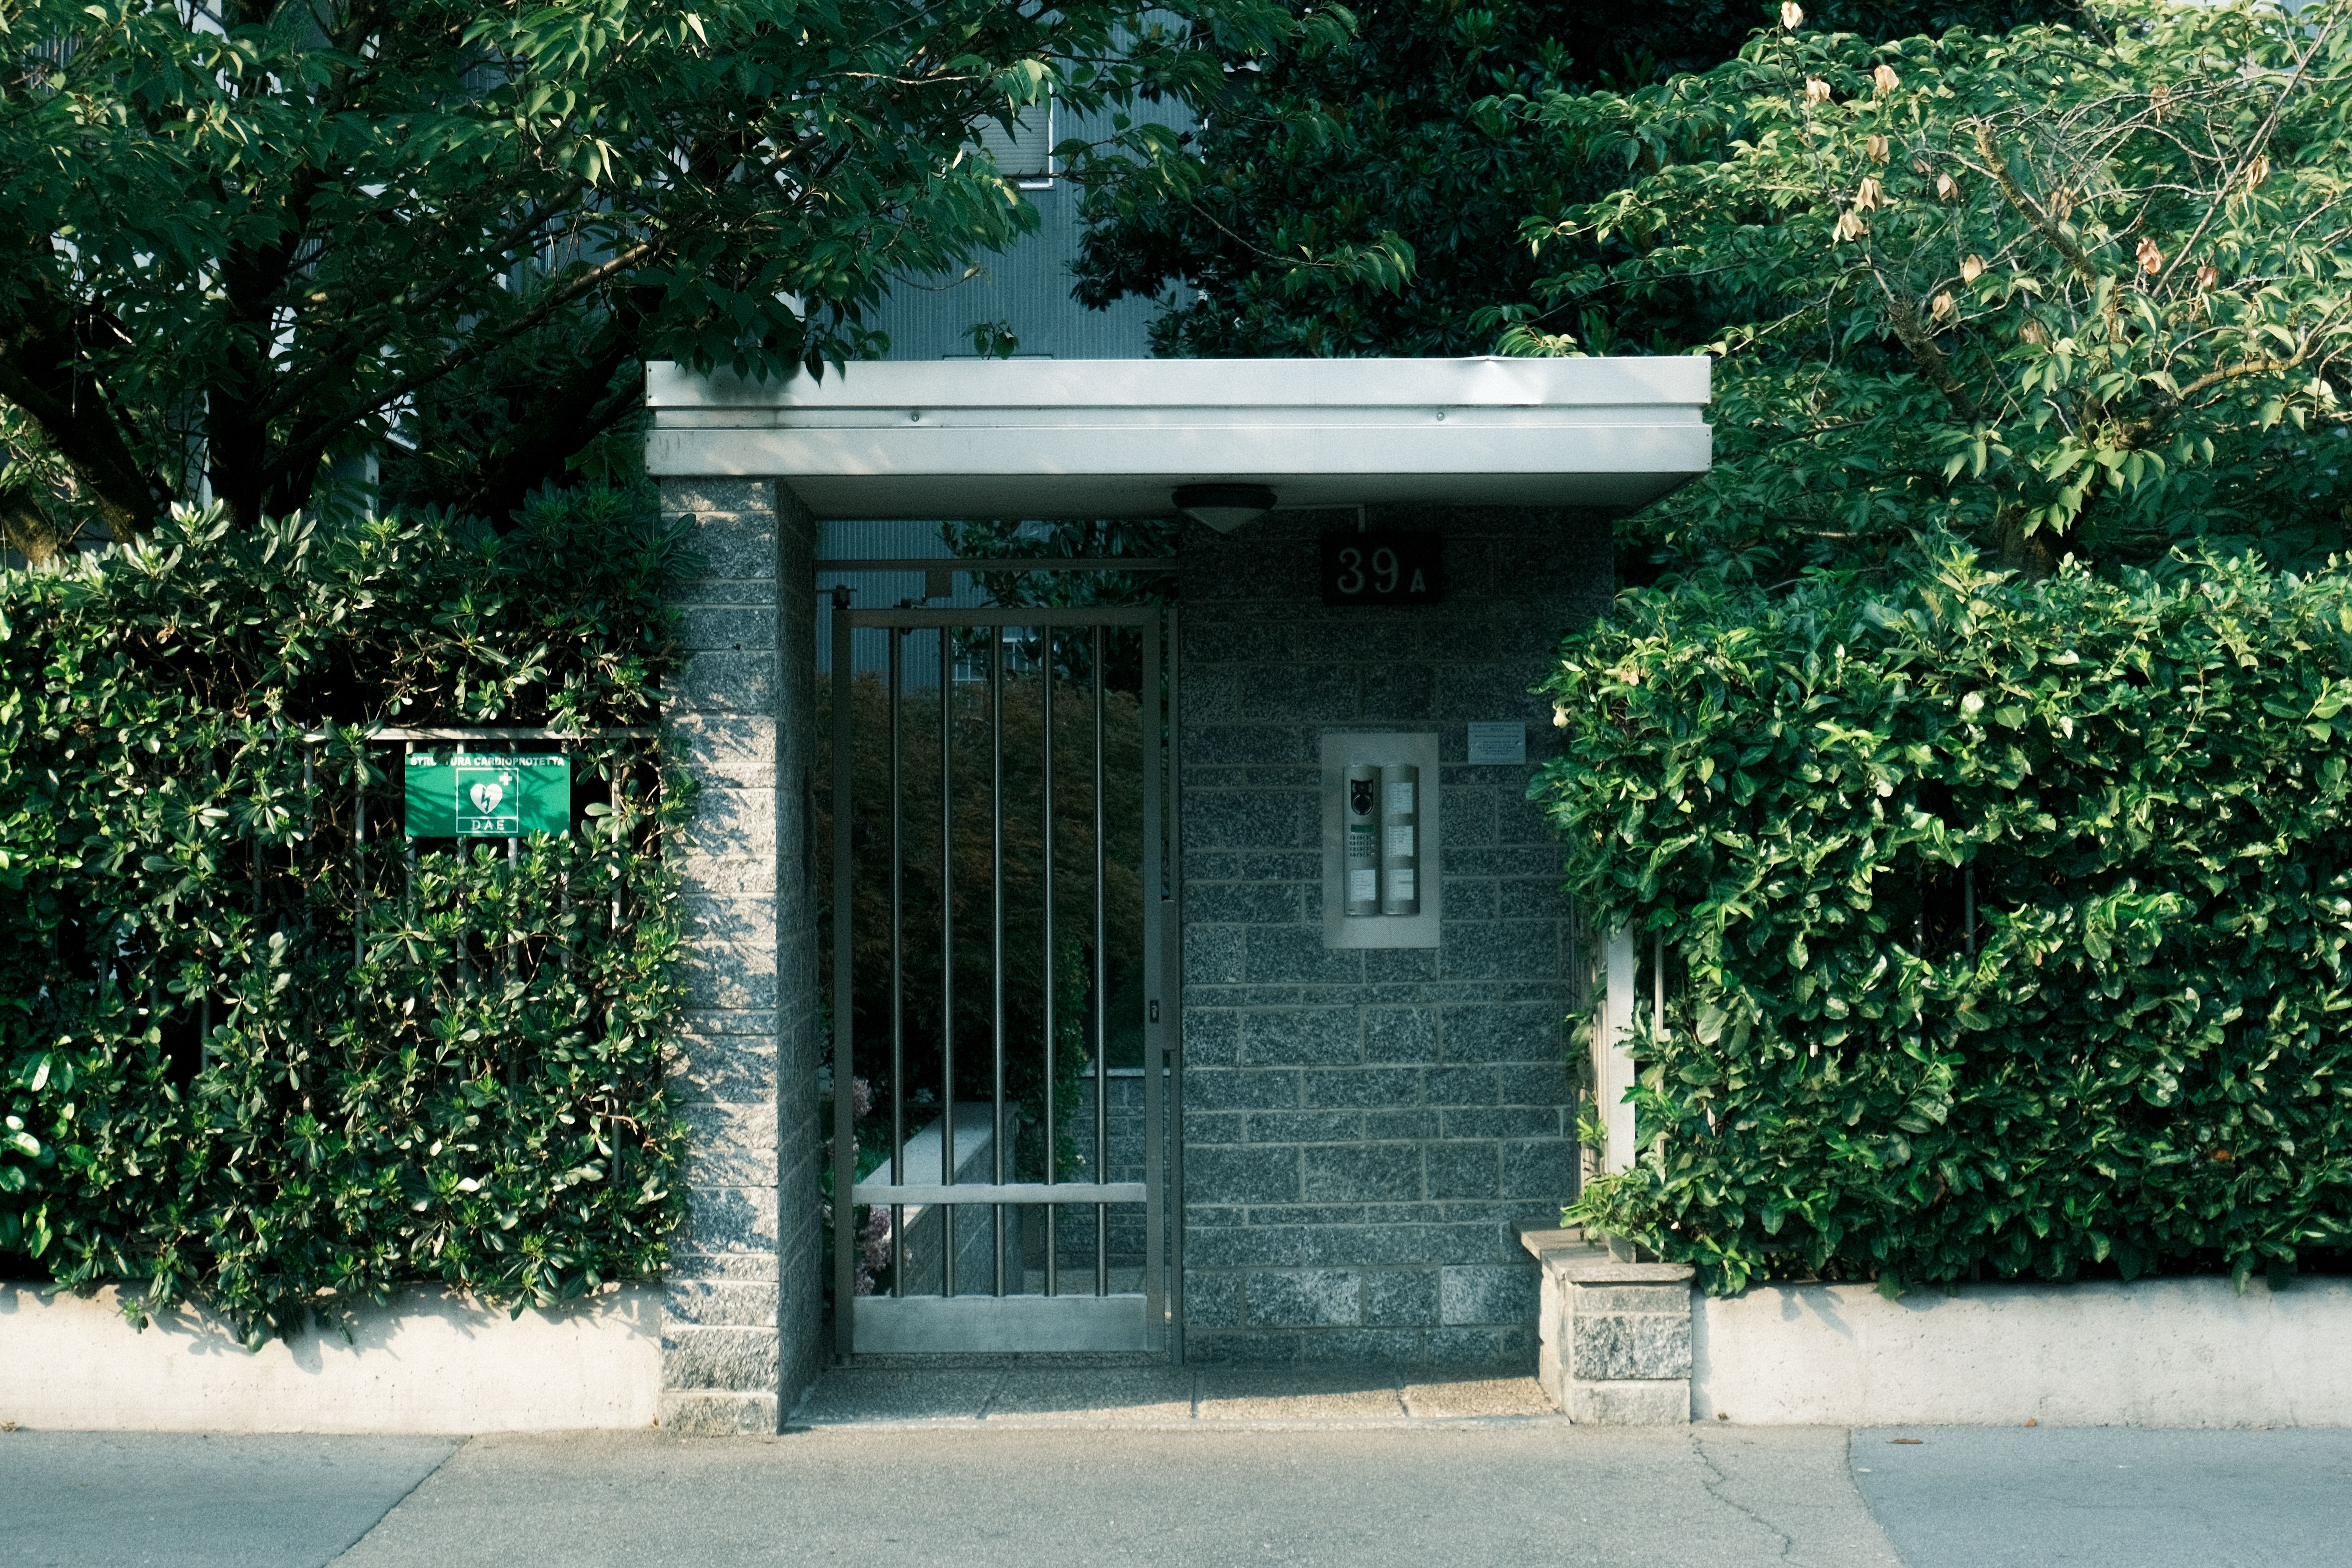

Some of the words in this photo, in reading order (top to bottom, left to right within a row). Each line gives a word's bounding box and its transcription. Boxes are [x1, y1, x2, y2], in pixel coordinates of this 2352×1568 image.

[410, 757, 472, 766] STRUURA
[474, 756, 565, 766] CARDIOPROTETTA
[472, 819, 504, 831] DAE
